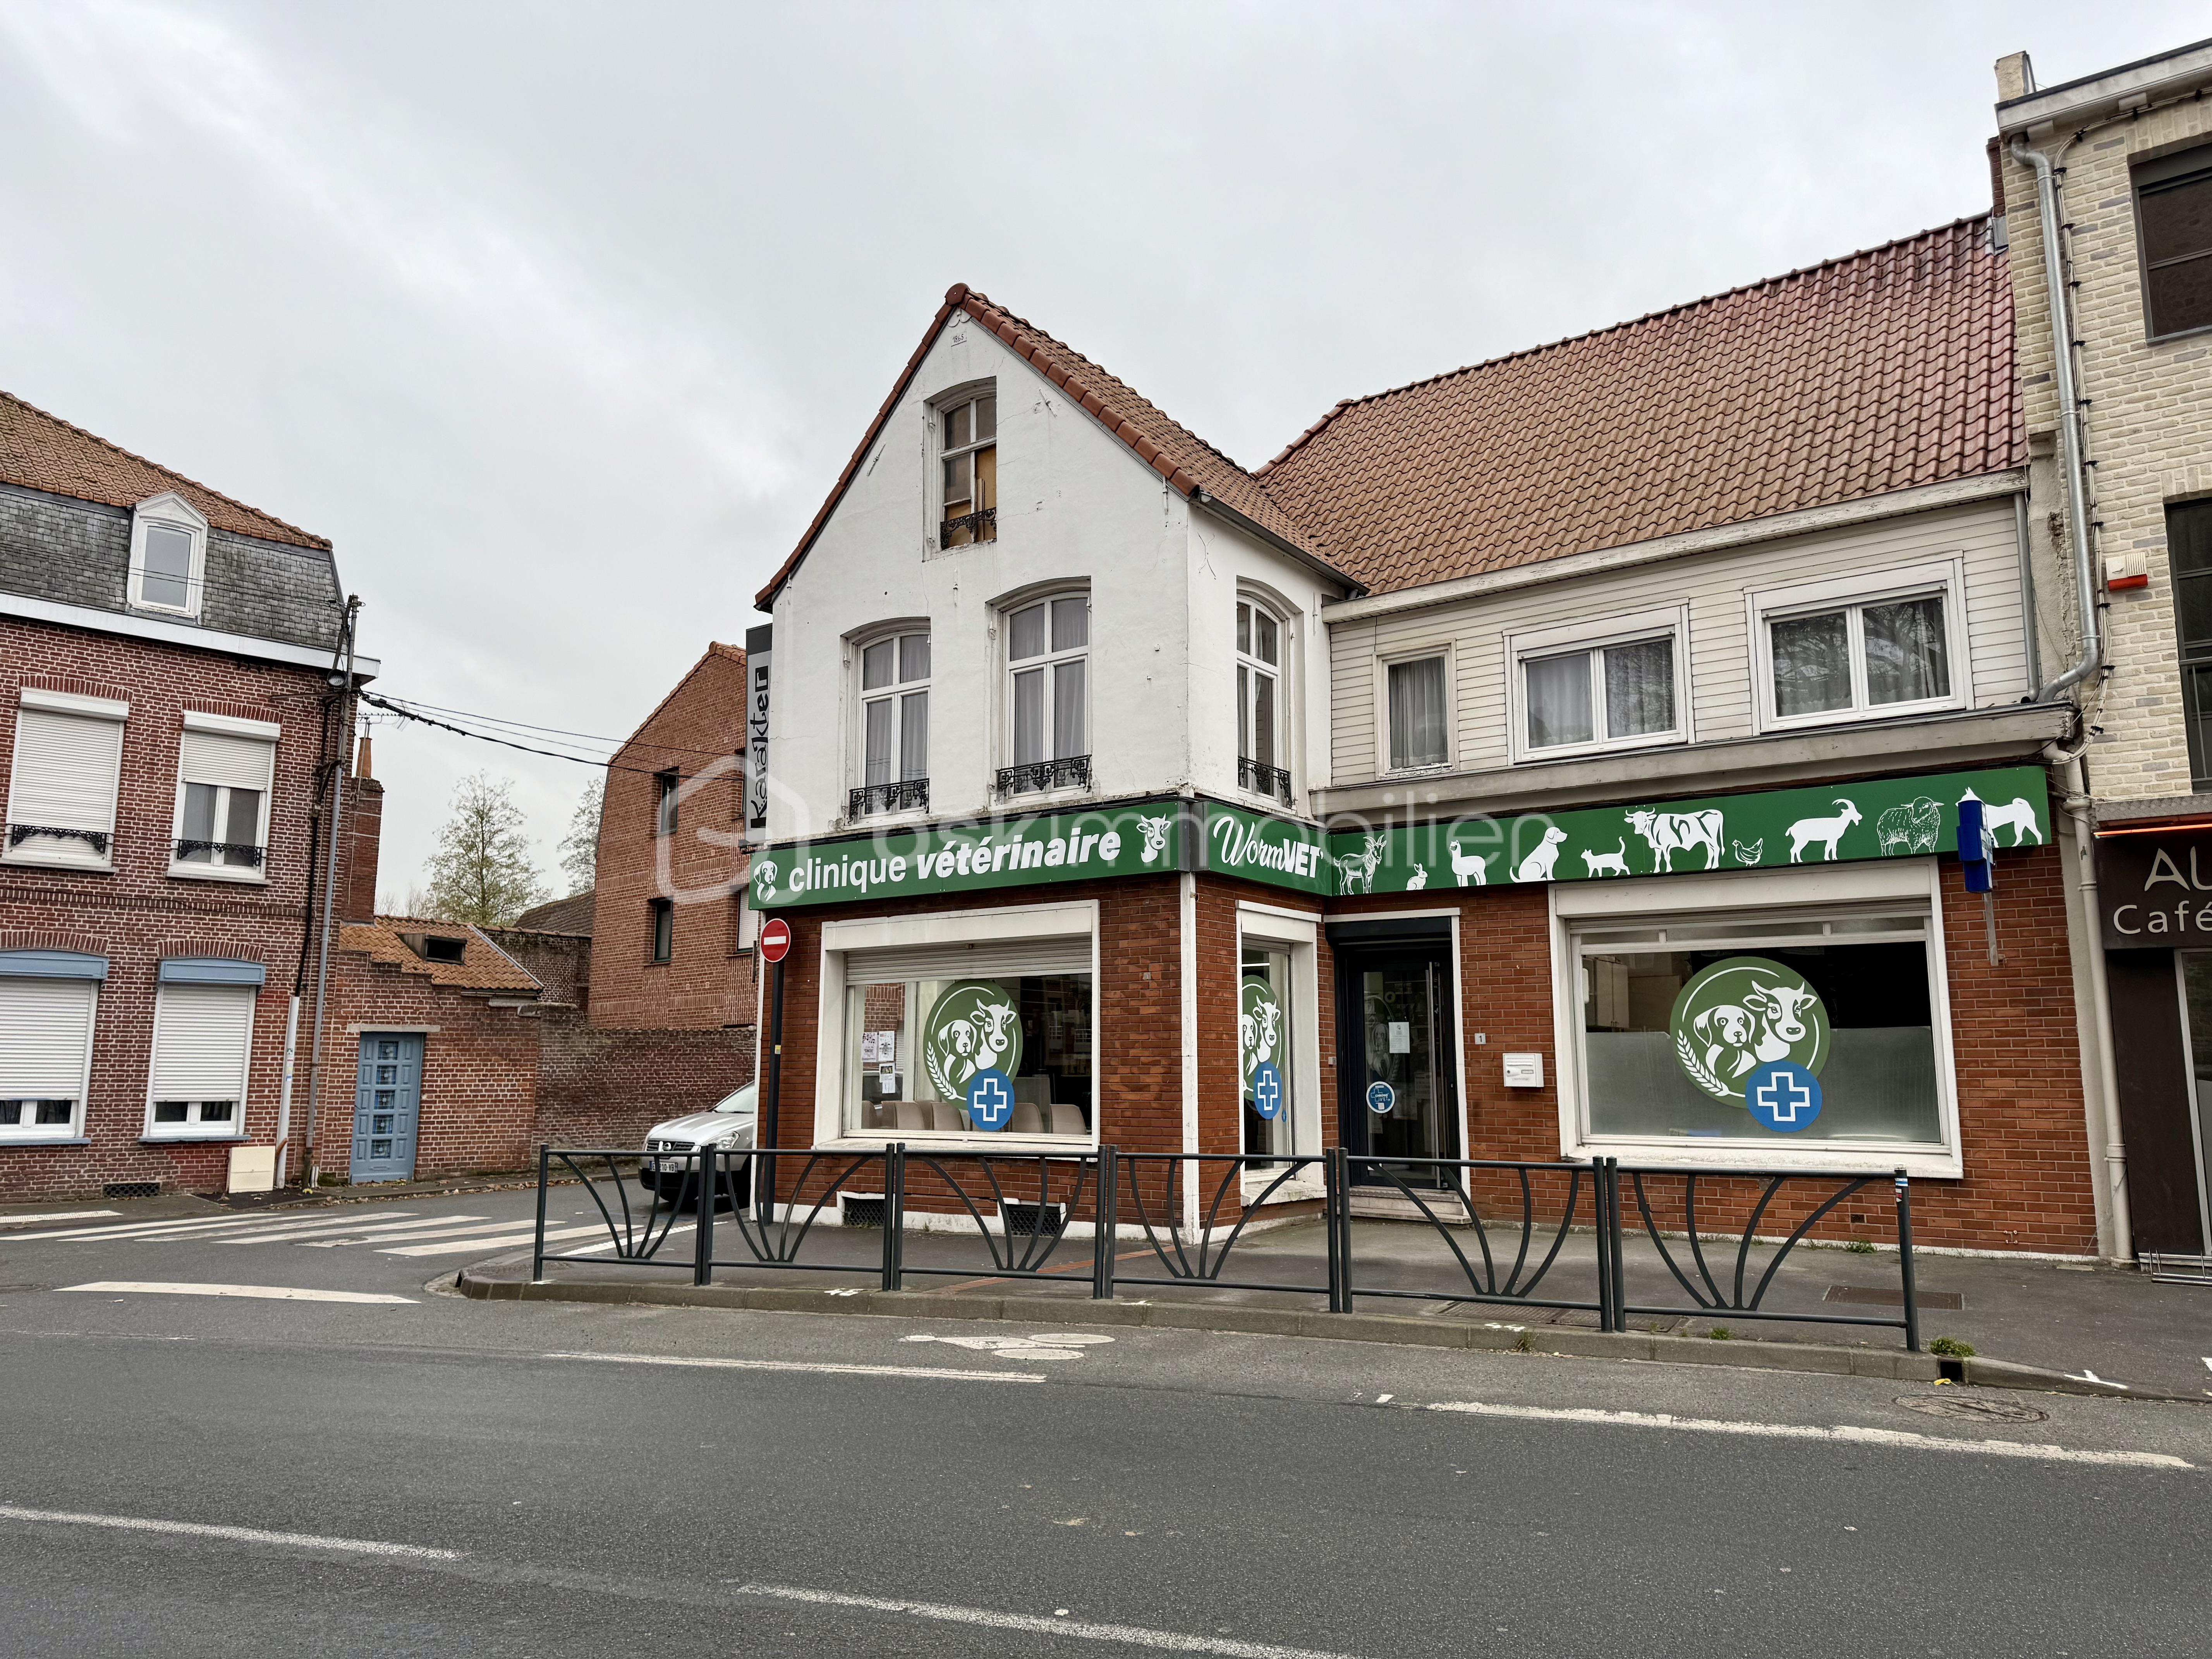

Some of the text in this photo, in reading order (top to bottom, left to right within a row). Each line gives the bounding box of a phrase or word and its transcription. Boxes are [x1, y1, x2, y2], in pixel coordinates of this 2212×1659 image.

[750, 665, 769, 828] Karakter
[789, 827, 1121, 893] clinique vétérinaire
[2113, 900, 2212, 934] Café
